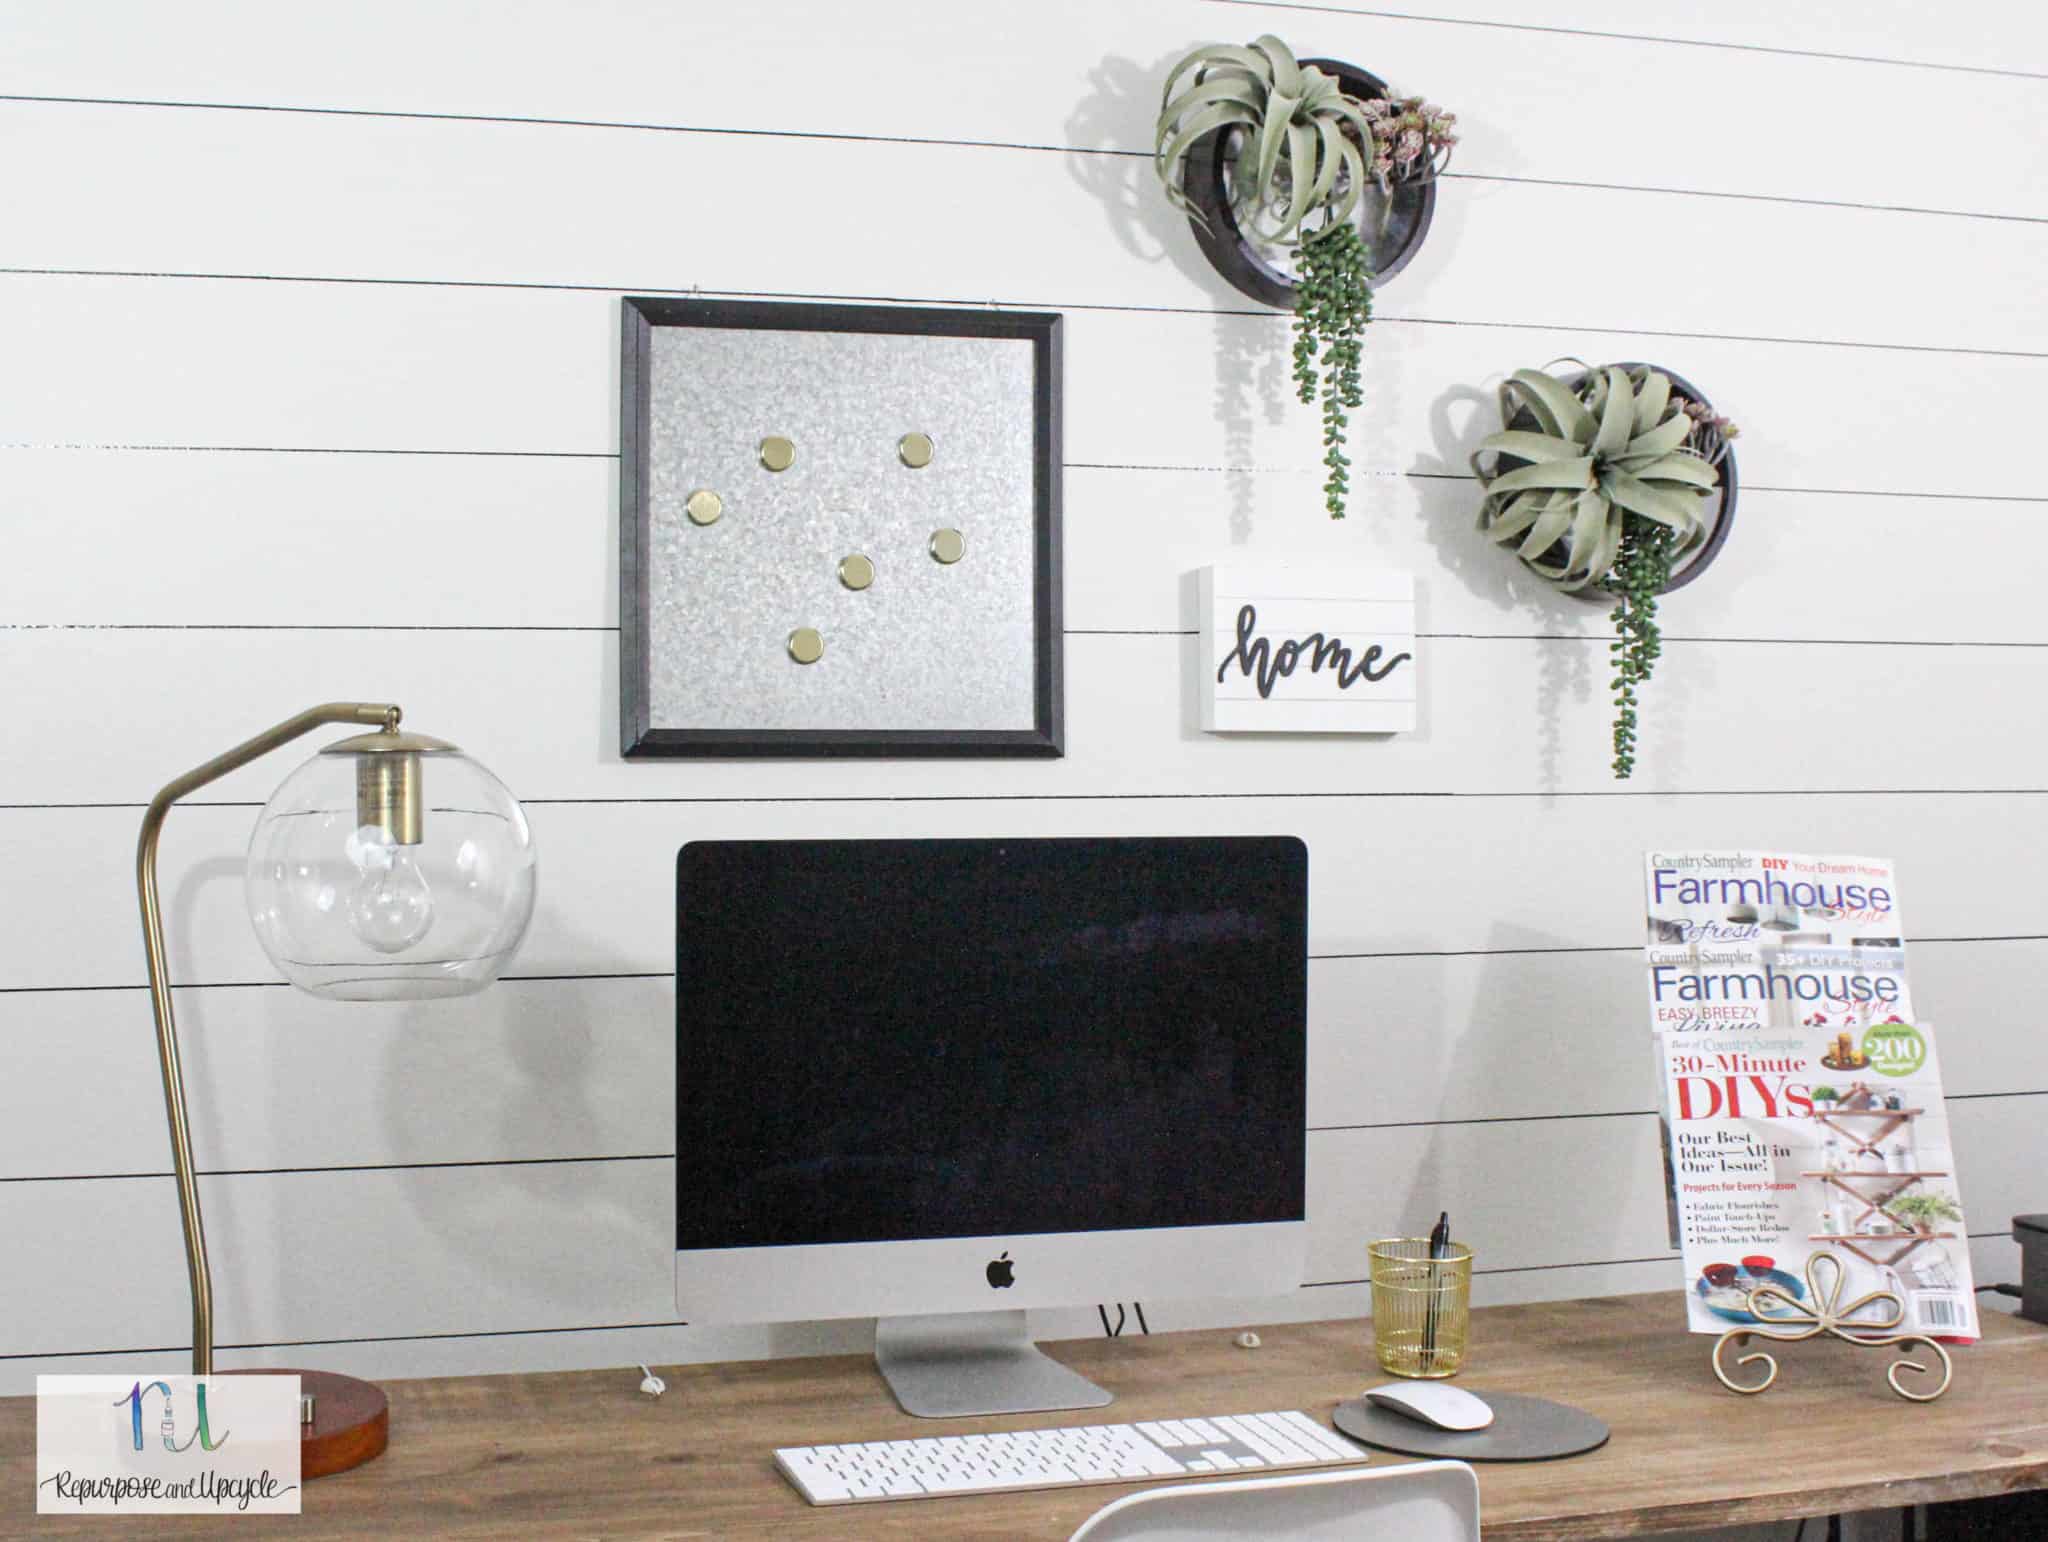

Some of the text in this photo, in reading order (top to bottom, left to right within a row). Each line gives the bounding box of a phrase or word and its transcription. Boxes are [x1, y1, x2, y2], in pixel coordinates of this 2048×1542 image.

[1218, 605, 1412, 699] home
[1761, 857, 1789, 870] DIY
[1654, 868, 1892, 912] Farmhouse
[1653, 964, 1899, 1002] Farmhouse
[1702, 1006, 1760, 1020] BREEZY
[1862, 1038, 1922, 1060] 200
[1672, 1053, 1807, 1073] 30-Minute
[1674, 1075, 1816, 1120] DIYs
[1679, 1130, 1752, 1144] Our Best
[1773, 1144, 1791, 1158] in
[1681, 1158, 1768, 1173] One Issue!
[1683, 1180, 1798, 1193] Projects for Every Season
